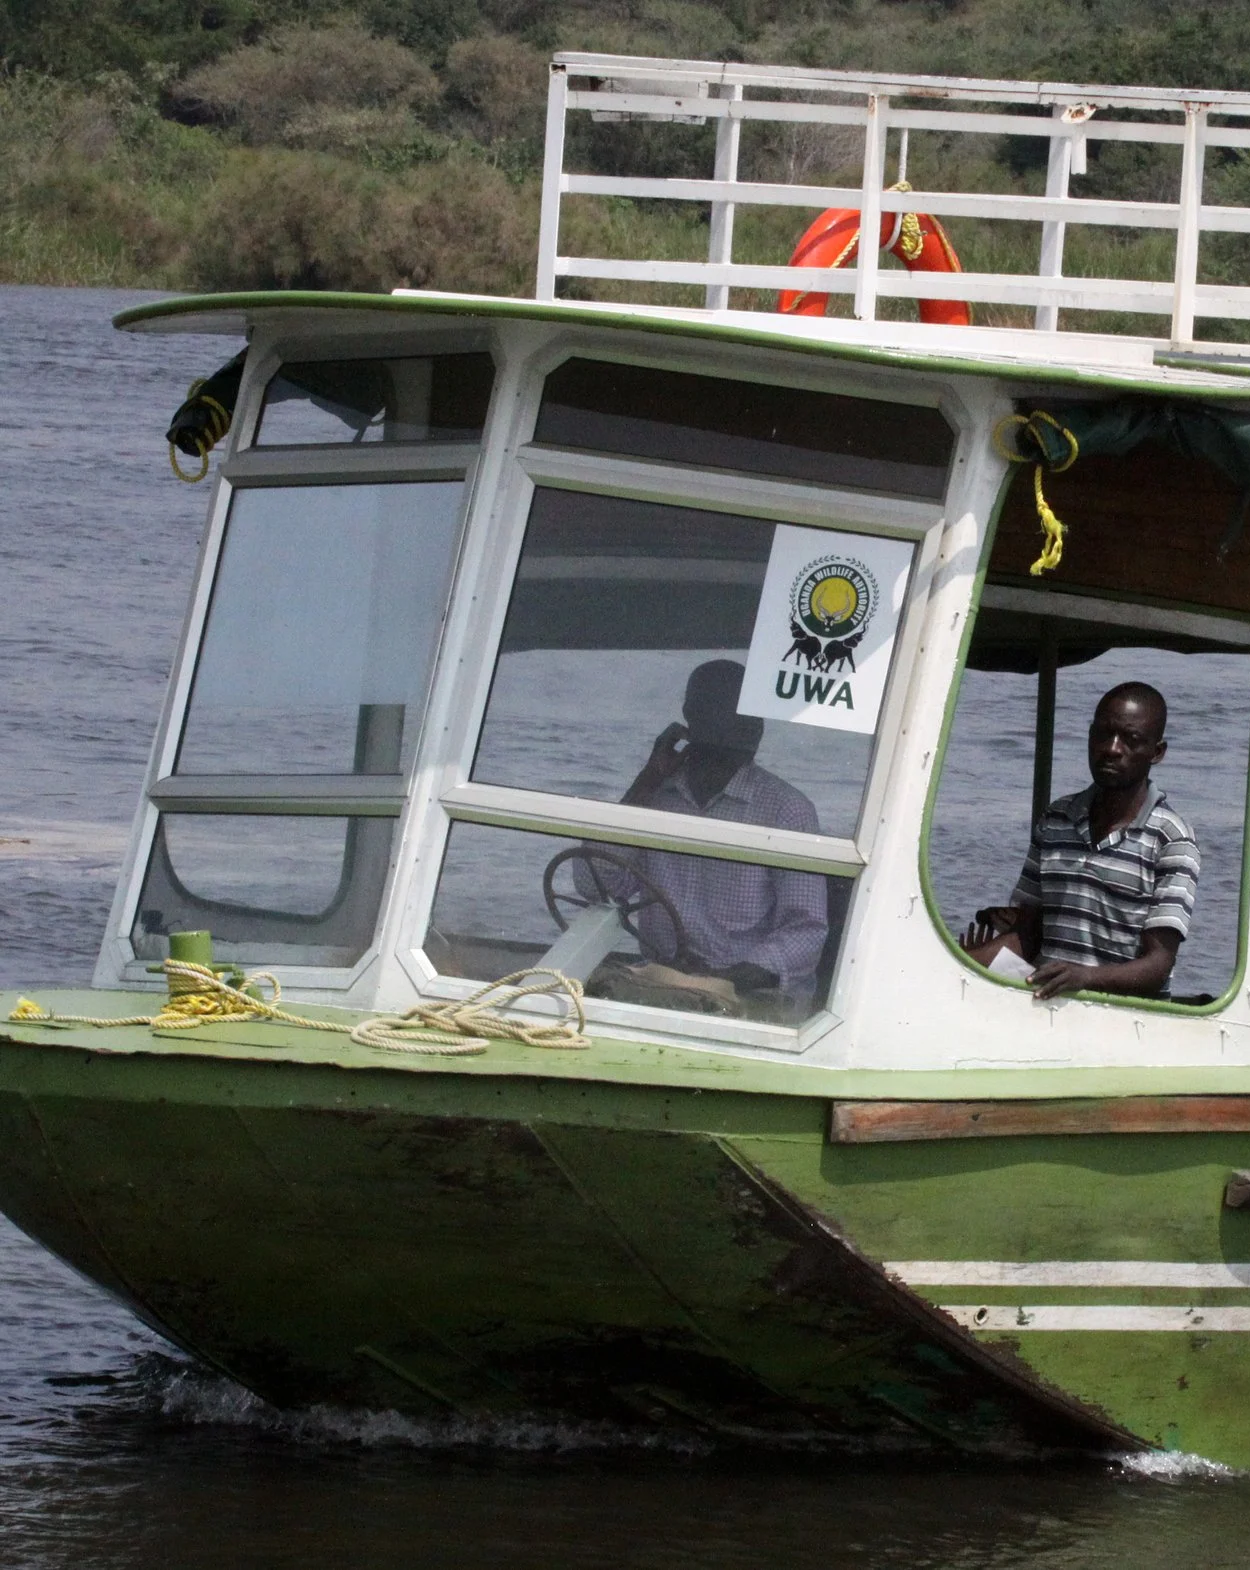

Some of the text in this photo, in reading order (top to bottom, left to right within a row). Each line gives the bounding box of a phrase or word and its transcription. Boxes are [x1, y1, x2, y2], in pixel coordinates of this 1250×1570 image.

[800, 566, 868, 626] UGANDA WILDLIFE AUTHORITY
[775, 669, 854, 709] UWA
